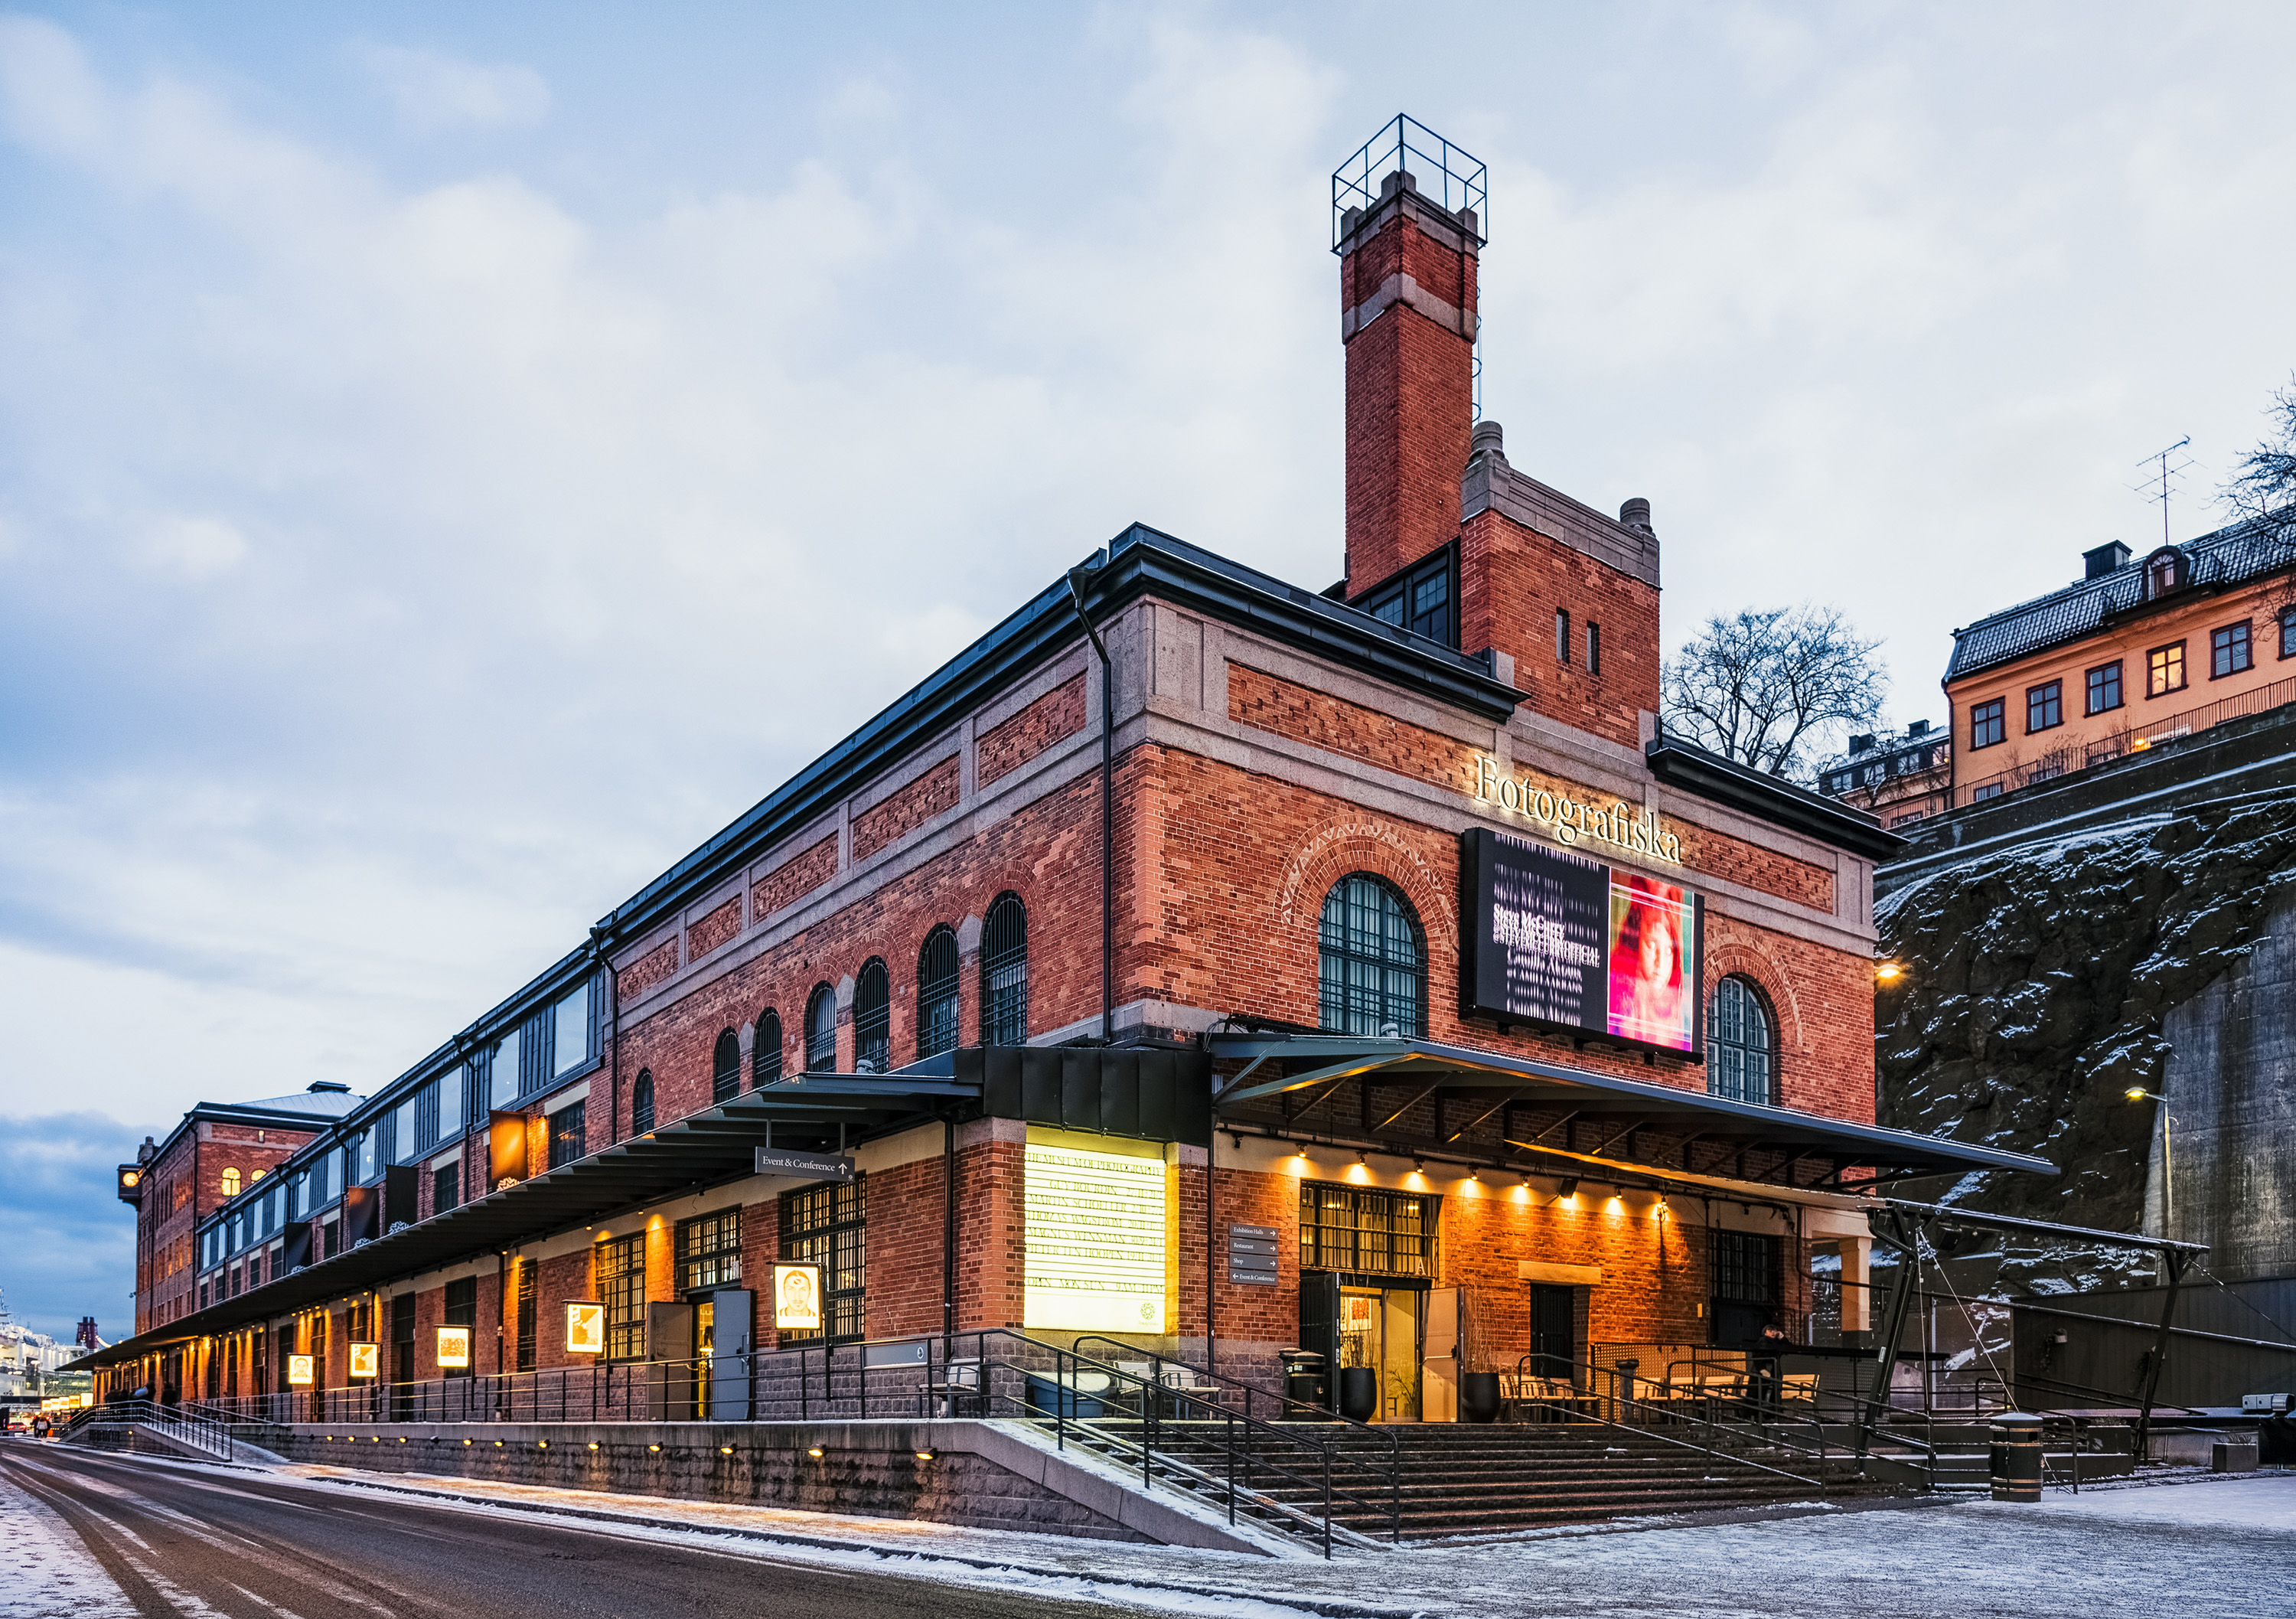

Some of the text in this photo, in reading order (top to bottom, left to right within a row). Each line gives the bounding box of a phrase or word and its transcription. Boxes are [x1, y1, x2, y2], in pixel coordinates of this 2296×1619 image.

[1475, 753, 1681, 865] Fotografiska
[762, 1155, 835, 1172] Event & Conference
[1026, 1152, 1160, 1177] THE MUSEUM OF PHOTOGRAPHY
[1049, 1180, 1069, 1190] GUY
[1074, 1181, 1117, 1194] BOURDIN
[1029, 1193, 1068, 1205] MARTIN
[1028, 1226, 1069, 1239] MAGNUS
[1414, 1256, 1427, 1276] A
[1027, 1276, 1051, 1288] OPEN
